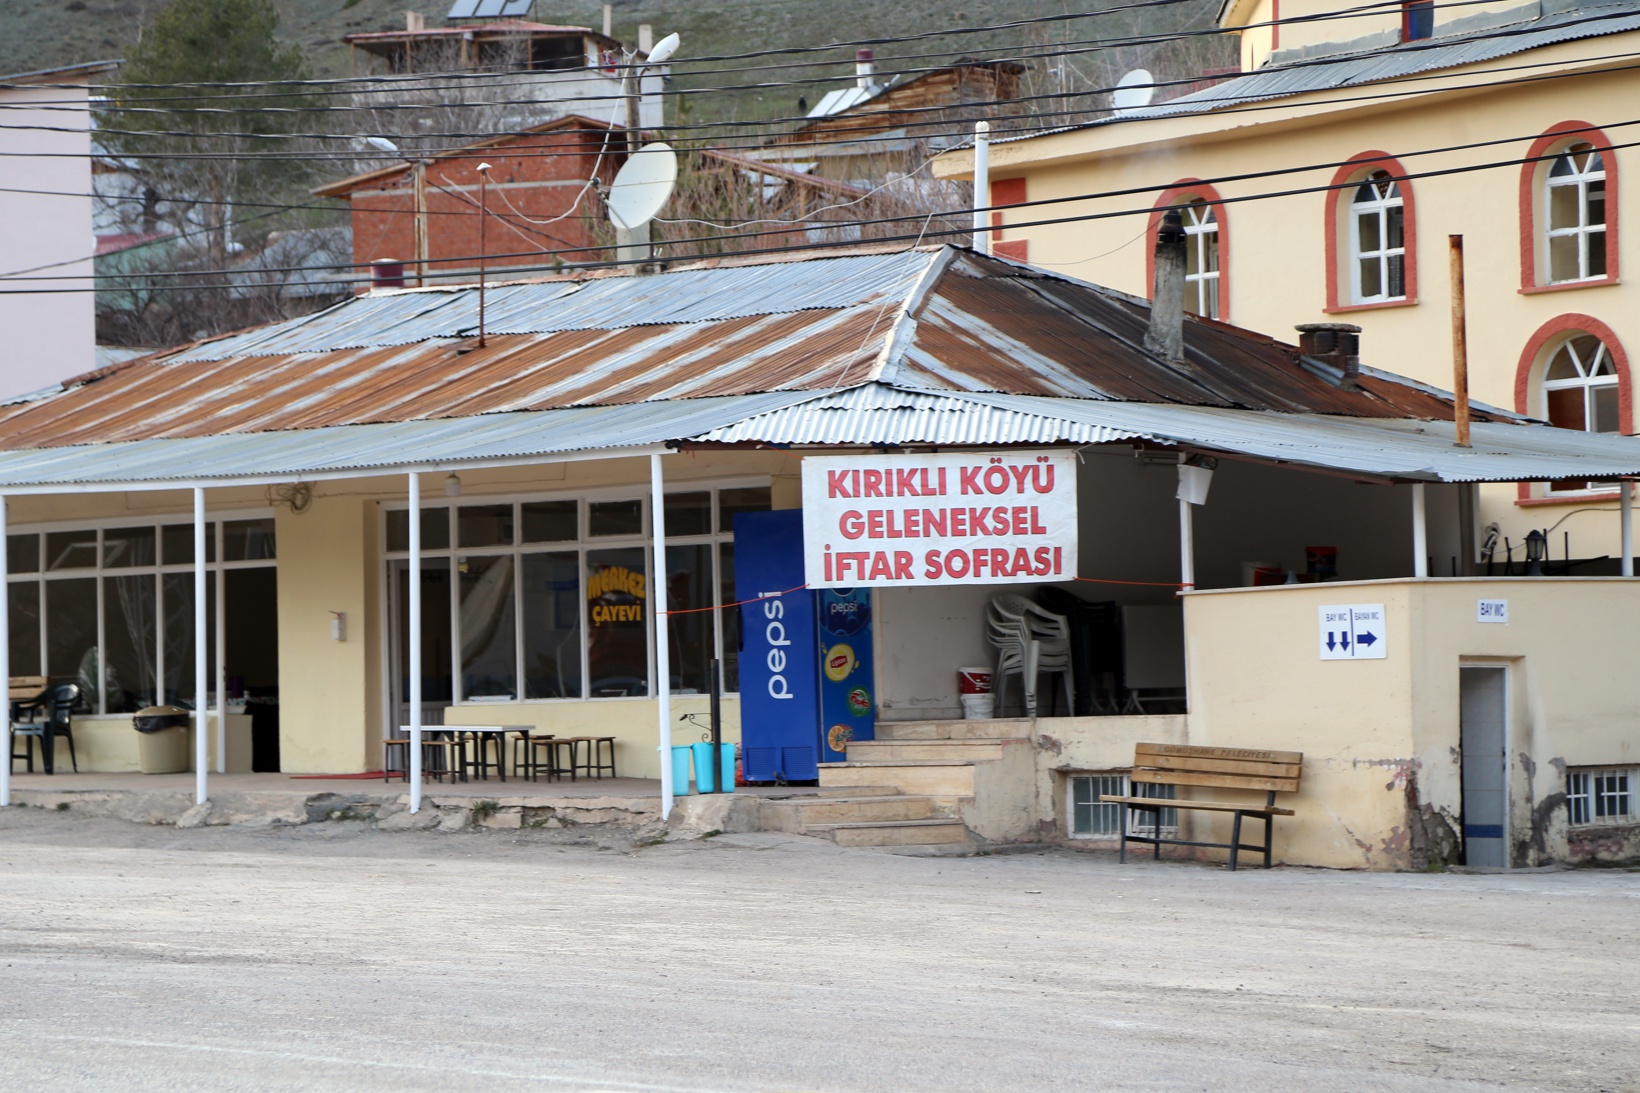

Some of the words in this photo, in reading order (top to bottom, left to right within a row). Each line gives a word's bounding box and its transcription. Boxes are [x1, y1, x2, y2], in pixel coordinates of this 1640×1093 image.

[827, 467, 947, 498] KIRIKLI
[960, 456, 1055, 495] KÖYÜ
[839, 506, 1047, 540] GELENEKSEL
[823, 544, 915, 581] İFTAR
[924, 546, 1062, 579] SOFRASI
[587, 566, 646, 600] MERKEZ
[592, 601, 641, 626] ÇAYEVİ
[831, 601, 857, 615] pepsi
[1326, 613, 1337, 621] BAY
[1338, 612, 1347, 621] WC
[1354, 612, 1370, 620] BAYAN
[1371, 611, 1379, 620] WC
[1481, 602, 1493, 616] BAY
[1494, 603, 1504, 616] WC
[758, 591, 794, 699] pepsi
